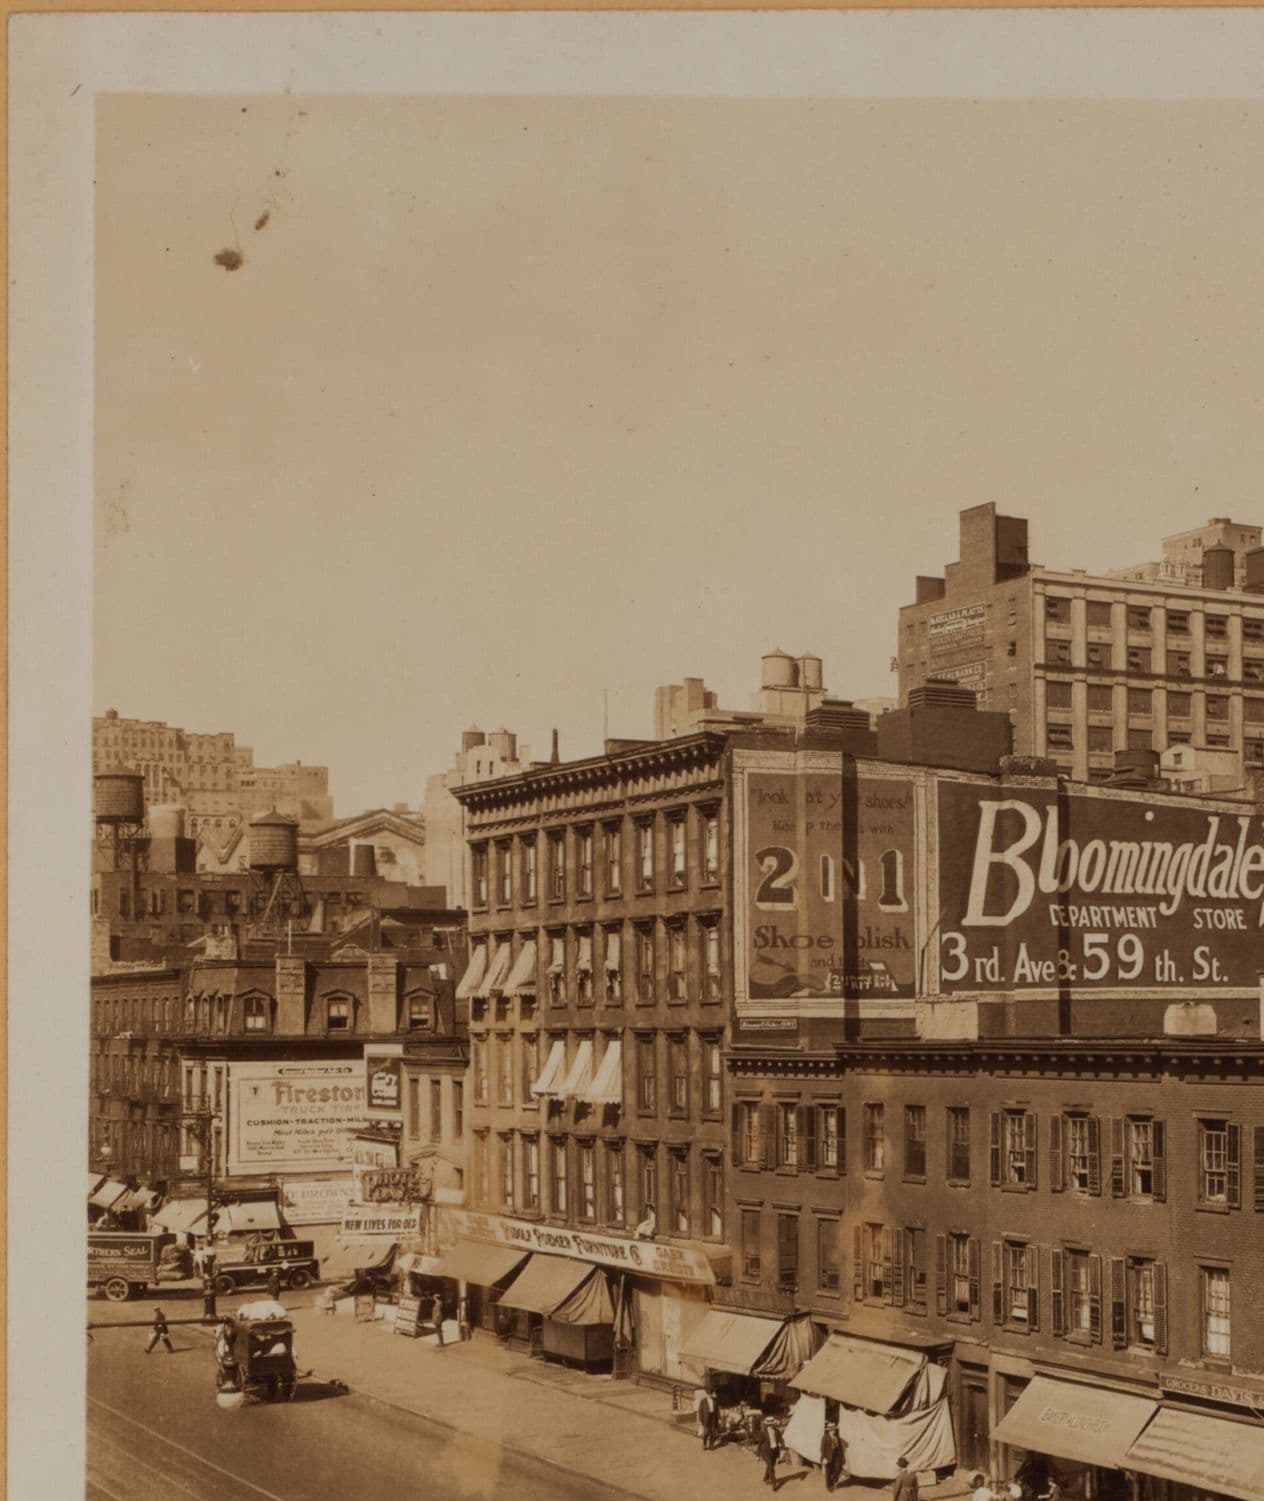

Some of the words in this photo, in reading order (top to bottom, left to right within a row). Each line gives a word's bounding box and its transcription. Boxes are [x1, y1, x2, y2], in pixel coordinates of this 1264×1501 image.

[755, 846, 798, 912] 2
[879, 849, 908, 913] 1
[1049, 904, 1157, 929] DEPARTMENT
[1193, 908, 1248, 930] STORE
[754, 925, 835, 949] Shoe
[855, 926, 915, 950] olish
[1193, 945, 1229, 982] St.
[271, 1080, 364, 1106] Fireston
[364, 1218, 386, 1231] LIVES
[387, 1218, 402, 1230] FOR
[403, 1217, 417, 1230] OLD
[123, 1246, 148, 1257] SEAL
[1165, 1379, 1208, 1394] GROCERS
